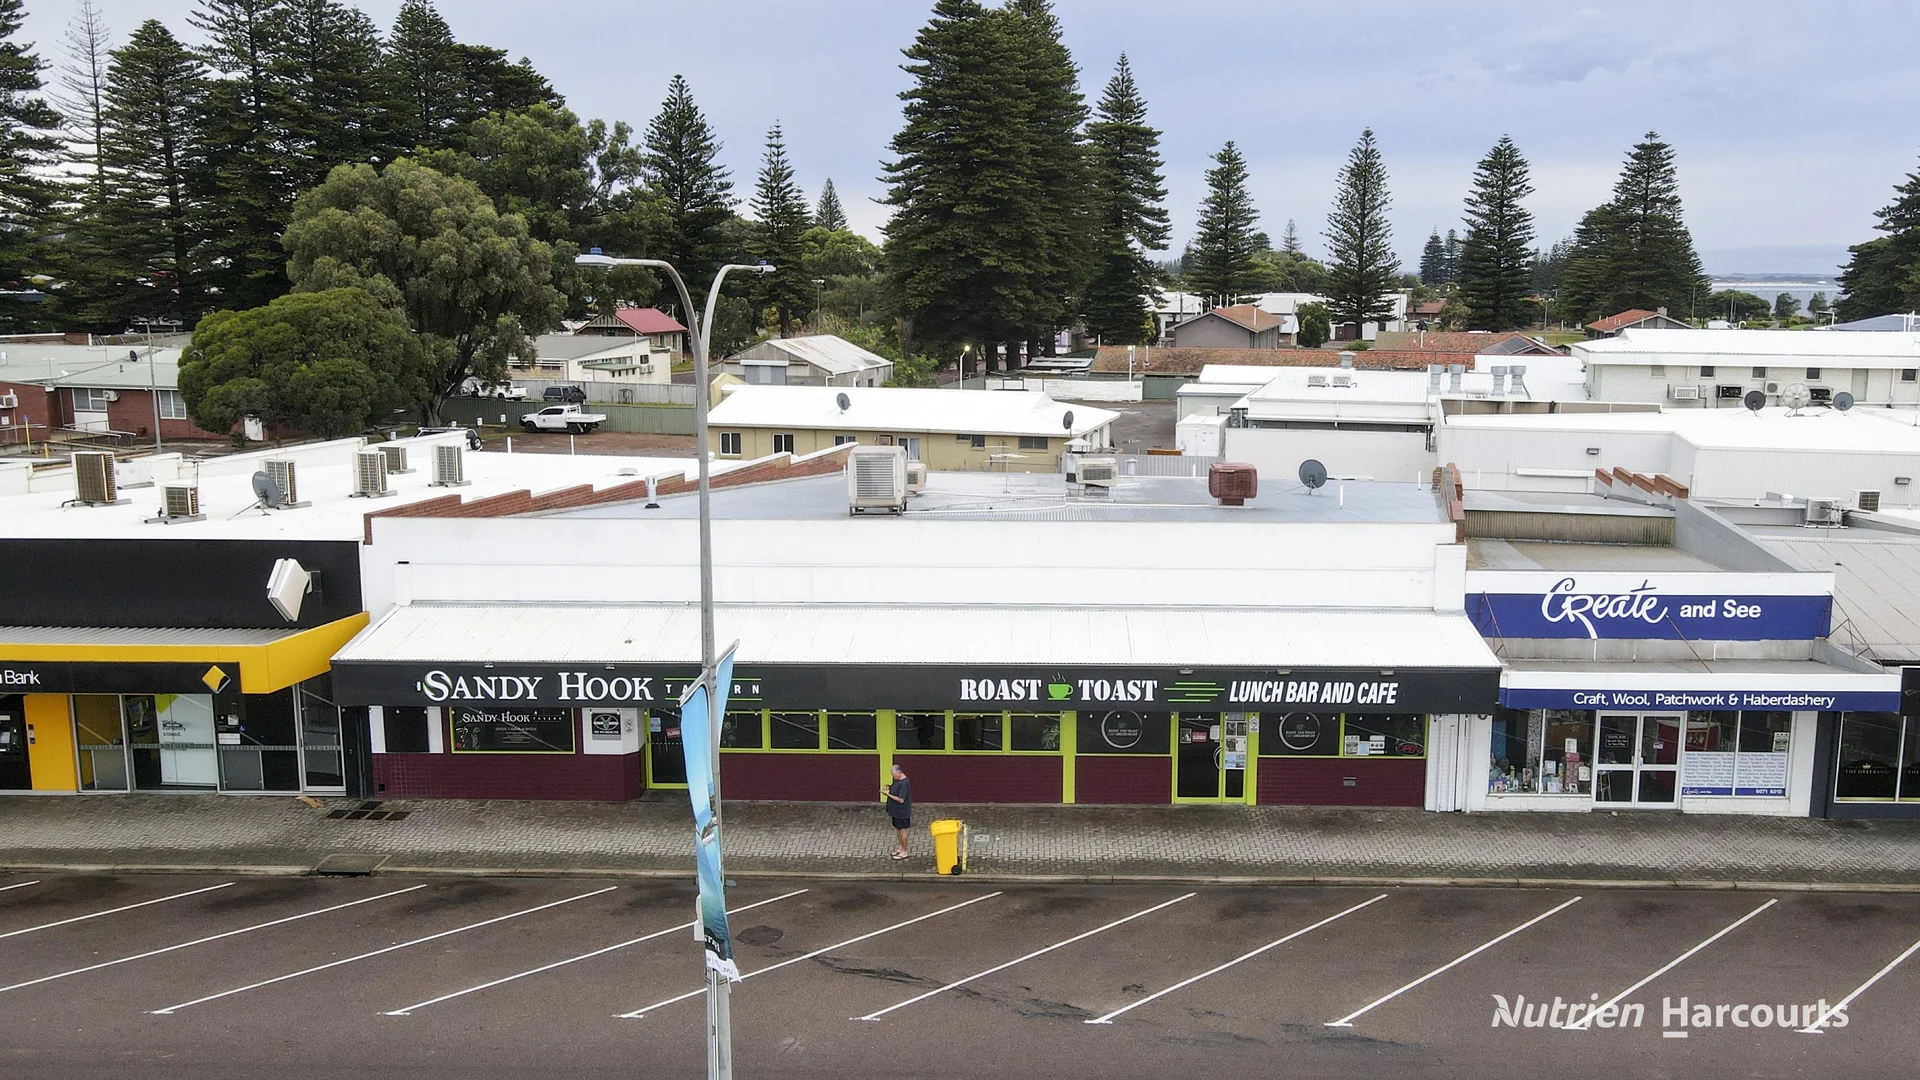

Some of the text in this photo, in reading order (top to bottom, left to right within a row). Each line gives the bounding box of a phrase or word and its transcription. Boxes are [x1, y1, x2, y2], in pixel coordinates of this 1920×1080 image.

[1679, 600, 1716, 618] and
[1723, 599, 1762, 618] See
[4, 669, 41, 685] Bank
[422, 670, 654, 702] SANDY HOOK
[665, 684, 760, 695] TARN
[960, 679, 1158, 702] ROAST TOAST
[1229, 680, 1399, 704] LUNCH BAR AND CAFE
[1573, 692, 1836, 709] Craft, Wool, Patchwork & Haberdashery
[462, 712, 531, 723] SANDY HOOK
